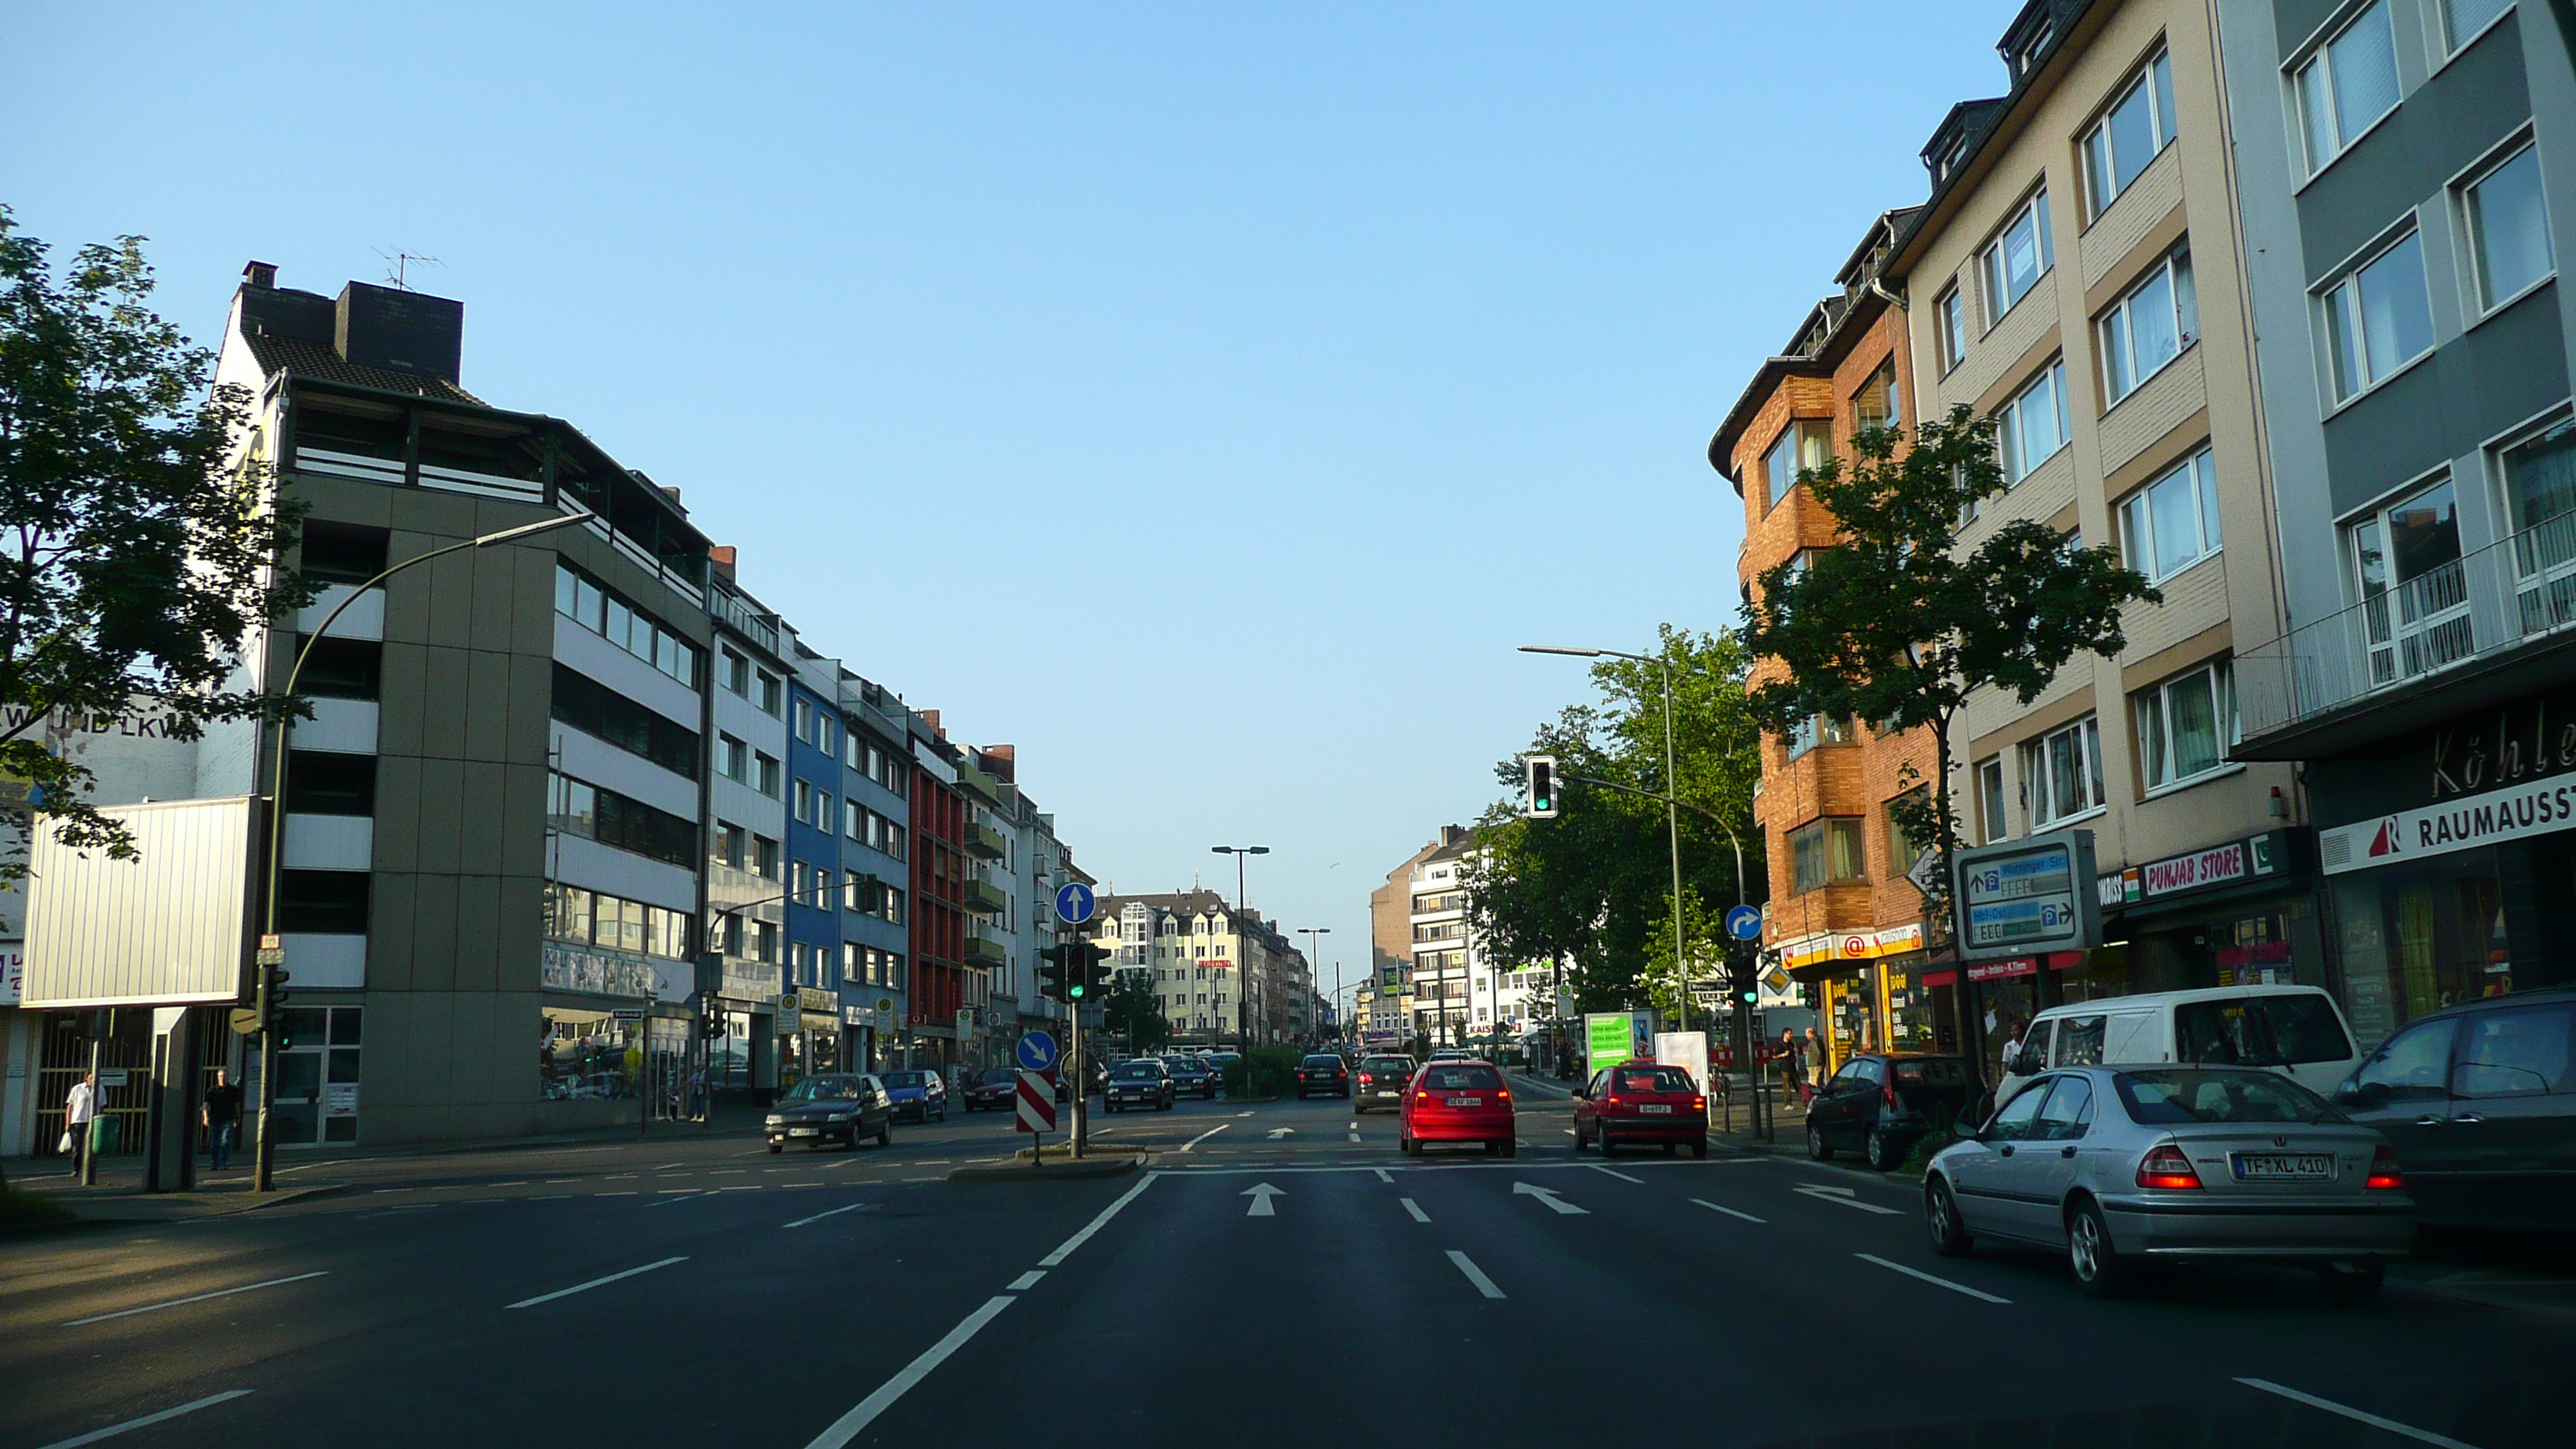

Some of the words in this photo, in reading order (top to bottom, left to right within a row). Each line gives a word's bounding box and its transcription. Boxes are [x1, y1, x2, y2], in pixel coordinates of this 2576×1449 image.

[2002, 860, 2046, 875] Worringer
[2148, 858, 2194, 892] PUNJAB
[2201, 846, 2240, 881] STORE
[2244, 1158, 2263, 1173] TF
[2275, 1158, 2293, 1173] XL
[2297, 1158, 2324, 1173] 410
